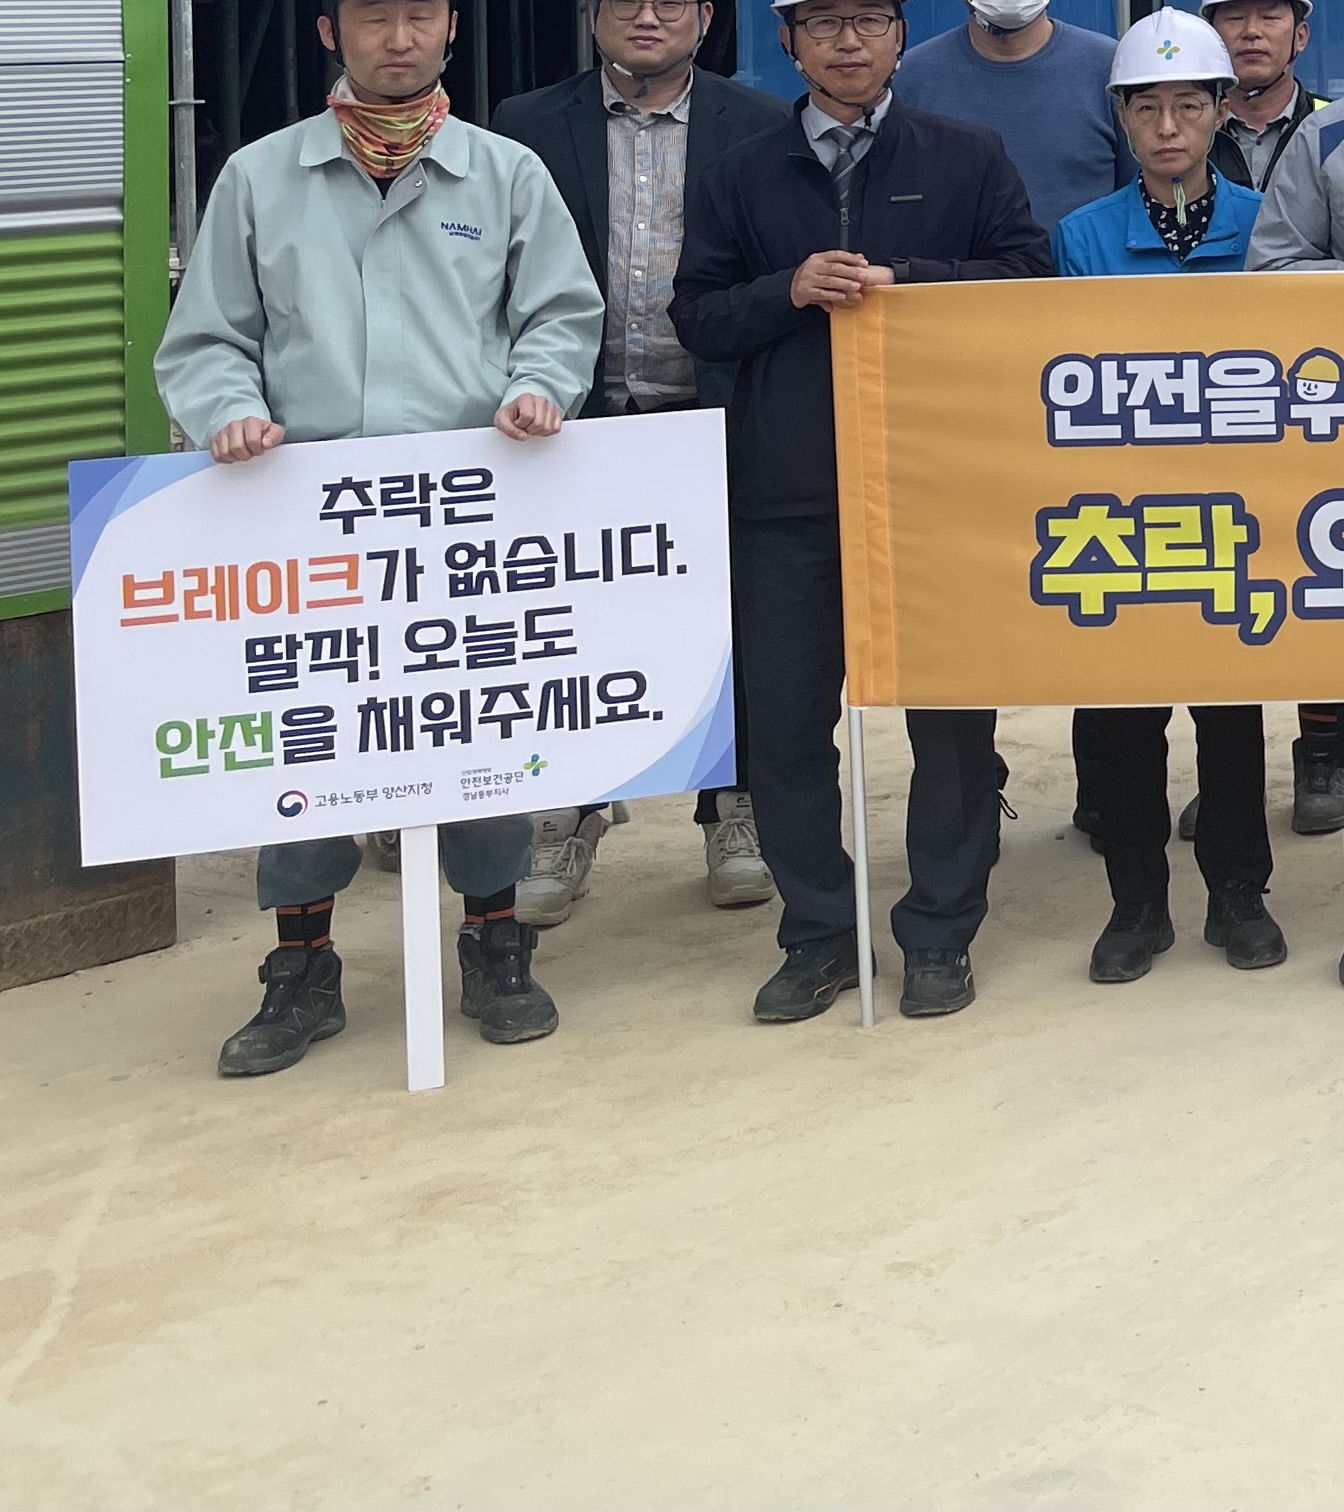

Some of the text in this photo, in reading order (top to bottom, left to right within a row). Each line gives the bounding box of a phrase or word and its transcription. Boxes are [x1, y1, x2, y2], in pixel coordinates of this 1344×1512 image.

[441, 221, 482, 236] NAMHAI
[318, 466, 497, 535] 추락은
[120, 522, 688, 628] 브레이크가 없습니다.
[1040, 502, 1276, 635] 추락,
[244, 604, 578, 694] 딸깍! 오늘도
[154, 669, 664, 779] 안전을 채워주세요.
[314, 781, 434, 809] 고용노동부 양산지청
[460, 771, 525, 789] 안전보건공단
